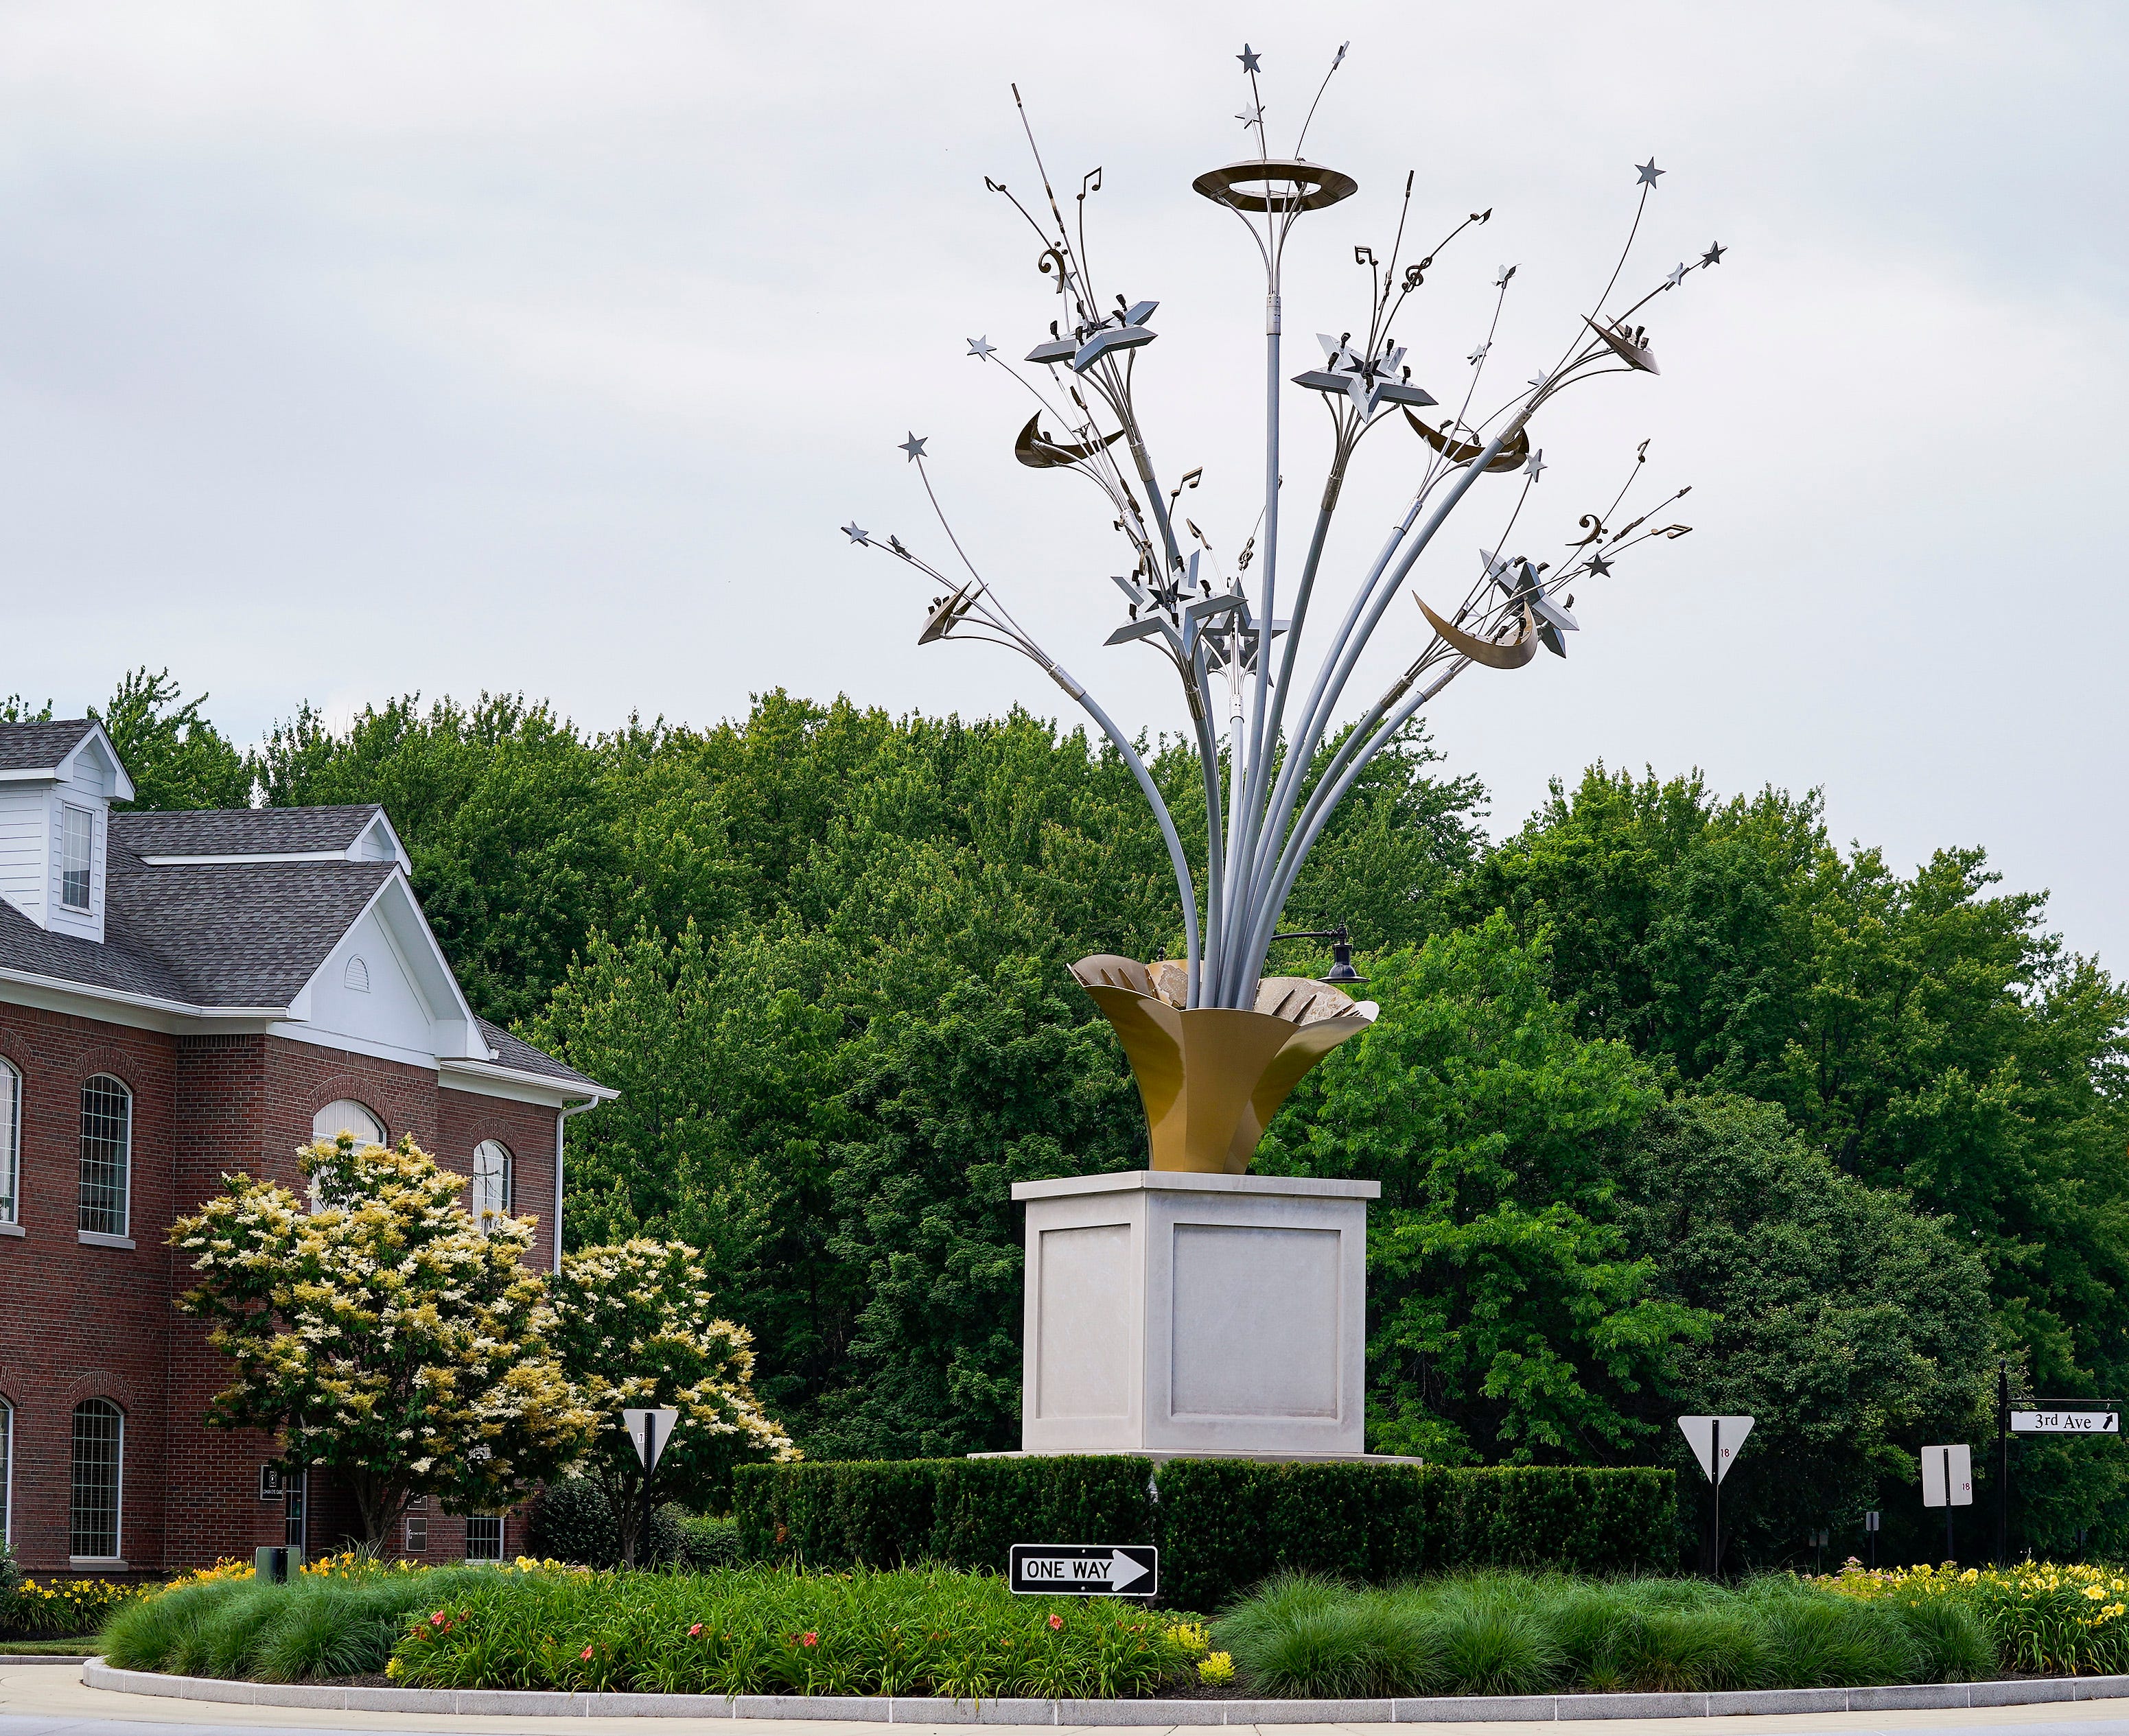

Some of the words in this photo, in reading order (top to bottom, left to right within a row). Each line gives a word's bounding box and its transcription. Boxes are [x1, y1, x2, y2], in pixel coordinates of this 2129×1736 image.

[2035, 1414, 2058, 1429] 3rd
[2063, 1414, 2091, 1429] Ave
[1721, 1448, 1730, 1457] 18
[1027, 1560, 1064, 1578] ONE
[1073, 1561, 1112, 1579] WAY
